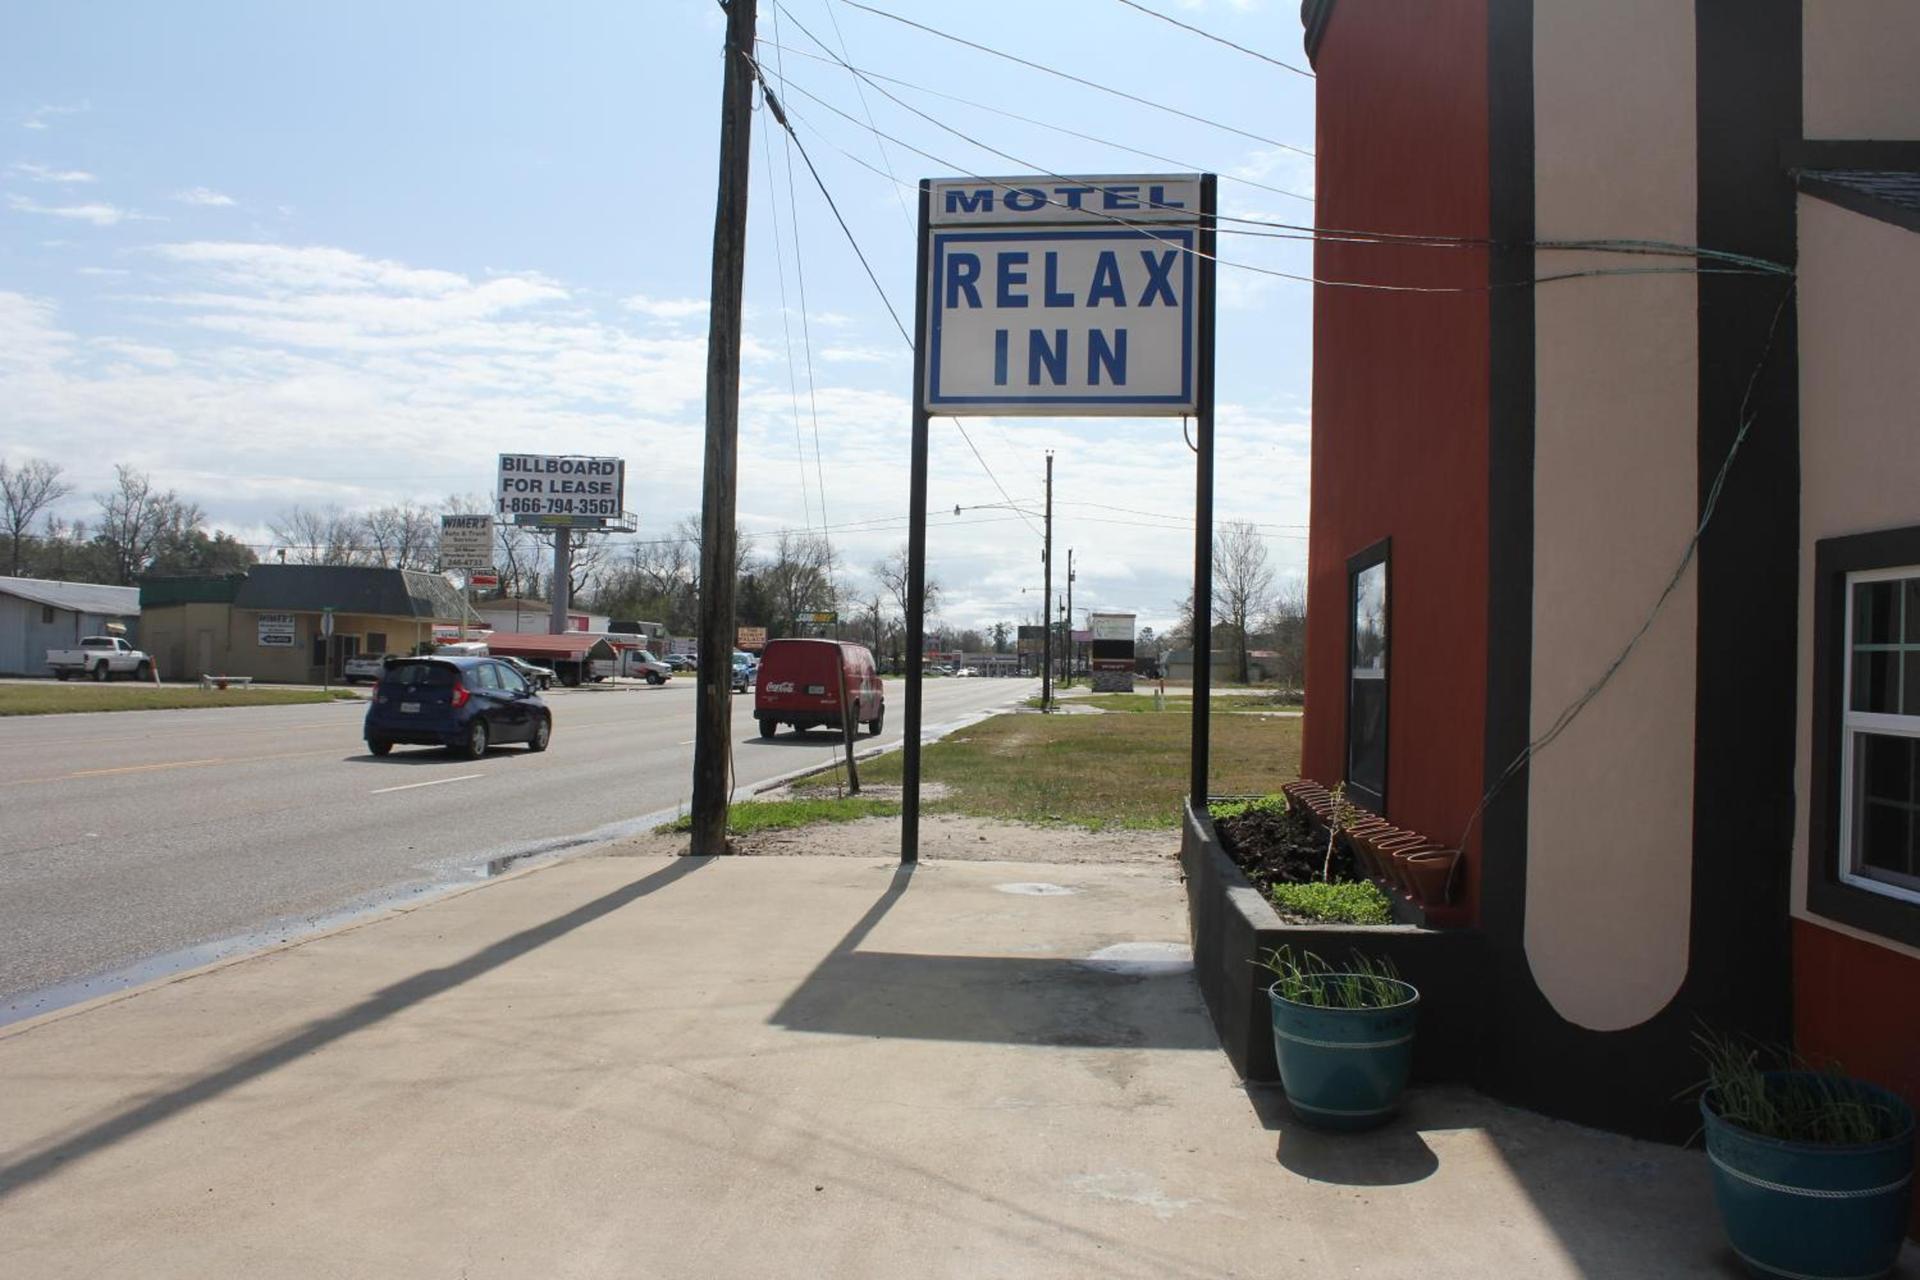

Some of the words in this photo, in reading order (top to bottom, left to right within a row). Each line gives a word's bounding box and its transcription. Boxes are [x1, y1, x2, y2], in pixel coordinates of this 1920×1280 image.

[944, 185, 1185, 213] MOTEL
[945, 250, 1179, 309] RELAX
[993, 328, 1128, 386] INN
[502, 457, 615, 476] BILLBOARD
[503, 478, 543, 493] FOR
[549, 480, 612, 495] LEASE
[498, 497, 616, 514] 1-866-794-3567
